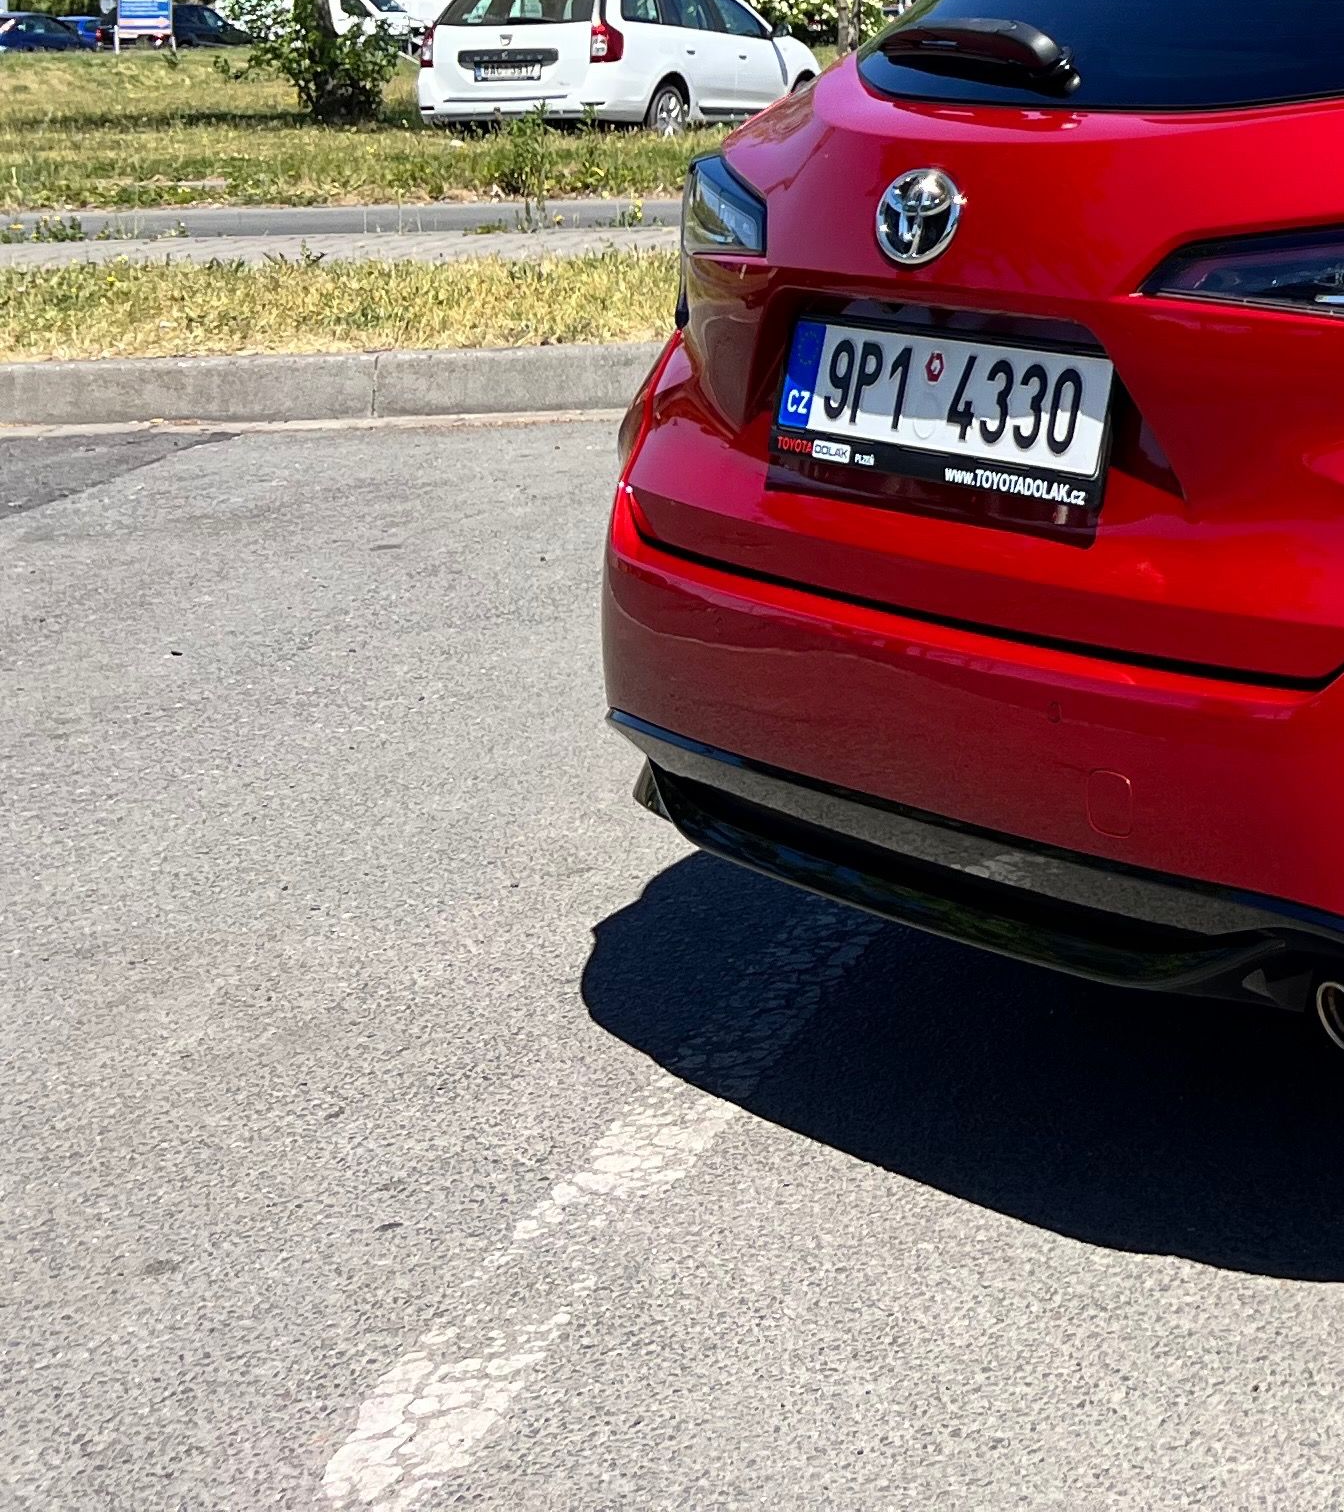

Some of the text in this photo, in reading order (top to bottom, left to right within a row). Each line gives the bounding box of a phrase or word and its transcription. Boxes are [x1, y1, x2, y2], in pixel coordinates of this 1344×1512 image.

[786, 338, 1083, 457] CZ 9P1 4330
[777, 435, 812, 455] TOYOTA
[814, 443, 849, 460] DOLAK
[944, 467, 1086, 506] www.TOYOTADOLAK.cz
